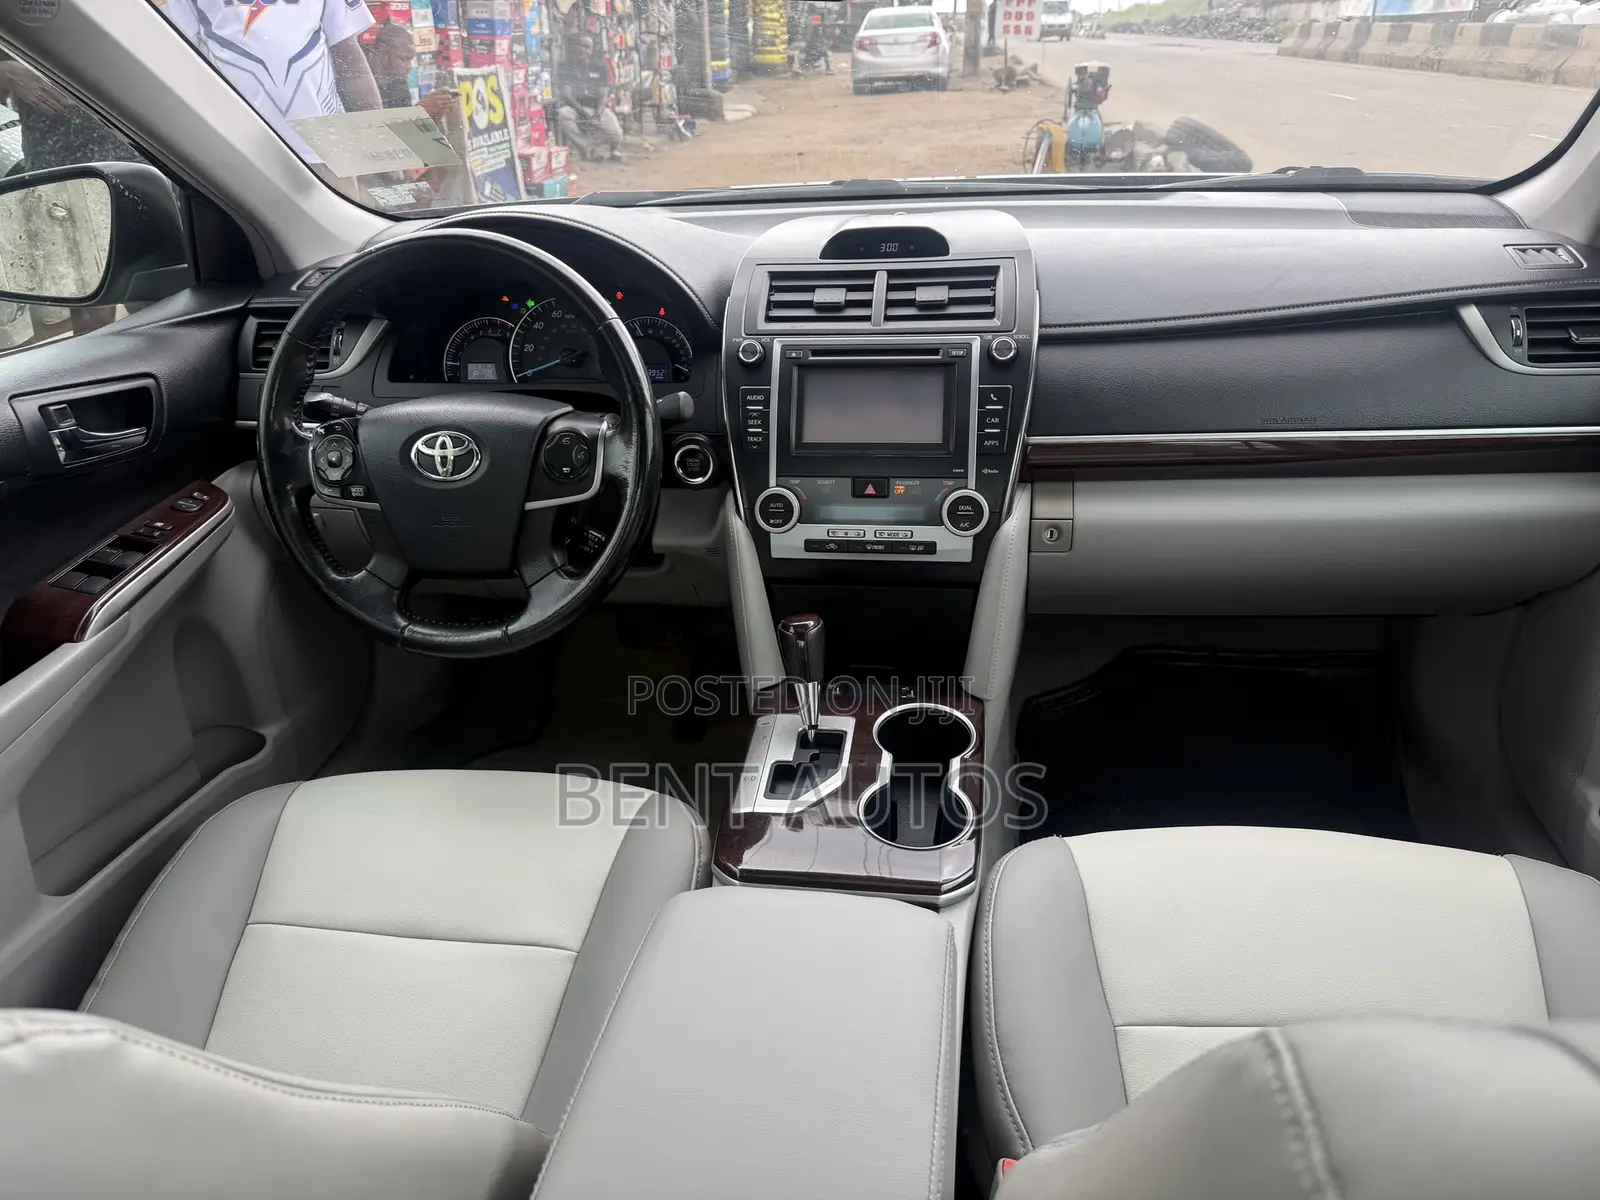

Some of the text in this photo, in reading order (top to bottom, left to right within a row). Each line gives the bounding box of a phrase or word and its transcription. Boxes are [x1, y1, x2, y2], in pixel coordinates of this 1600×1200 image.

[459, 74, 504, 132] POS
[552, 310, 563, 318] 60
[524, 344, 535, 352] 20
